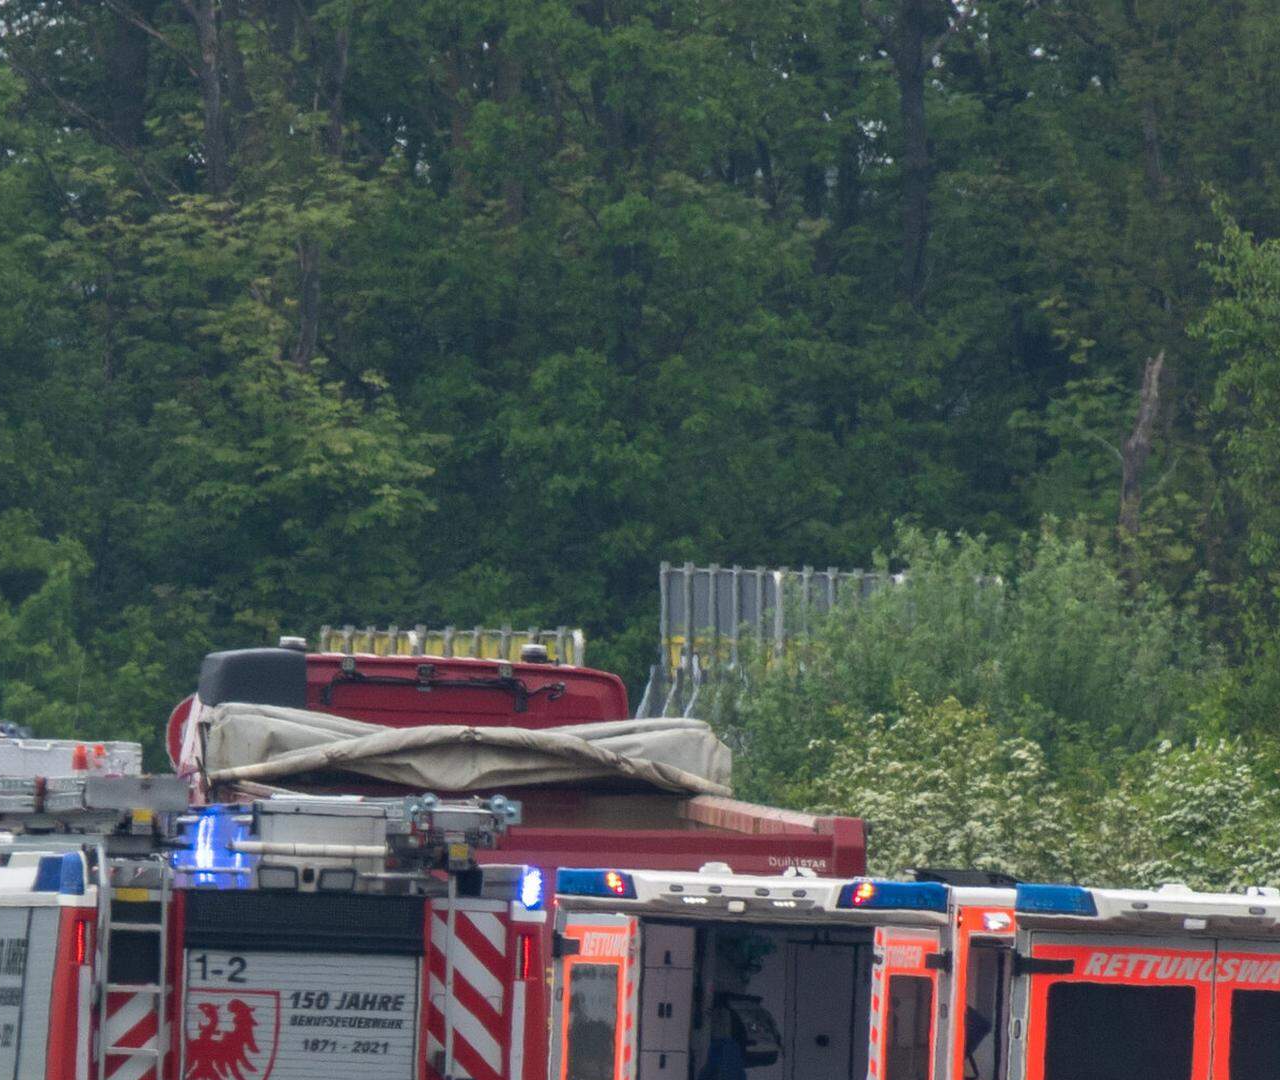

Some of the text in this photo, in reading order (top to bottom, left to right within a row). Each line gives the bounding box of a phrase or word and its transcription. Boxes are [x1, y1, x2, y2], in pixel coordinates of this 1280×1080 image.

[195, 953, 247, 984] 1-2
[290, 991, 406, 1012] 150 JAHRE
[301, 1038, 339, 1054] 1871
[351, 1040, 390, 1056] 2021
